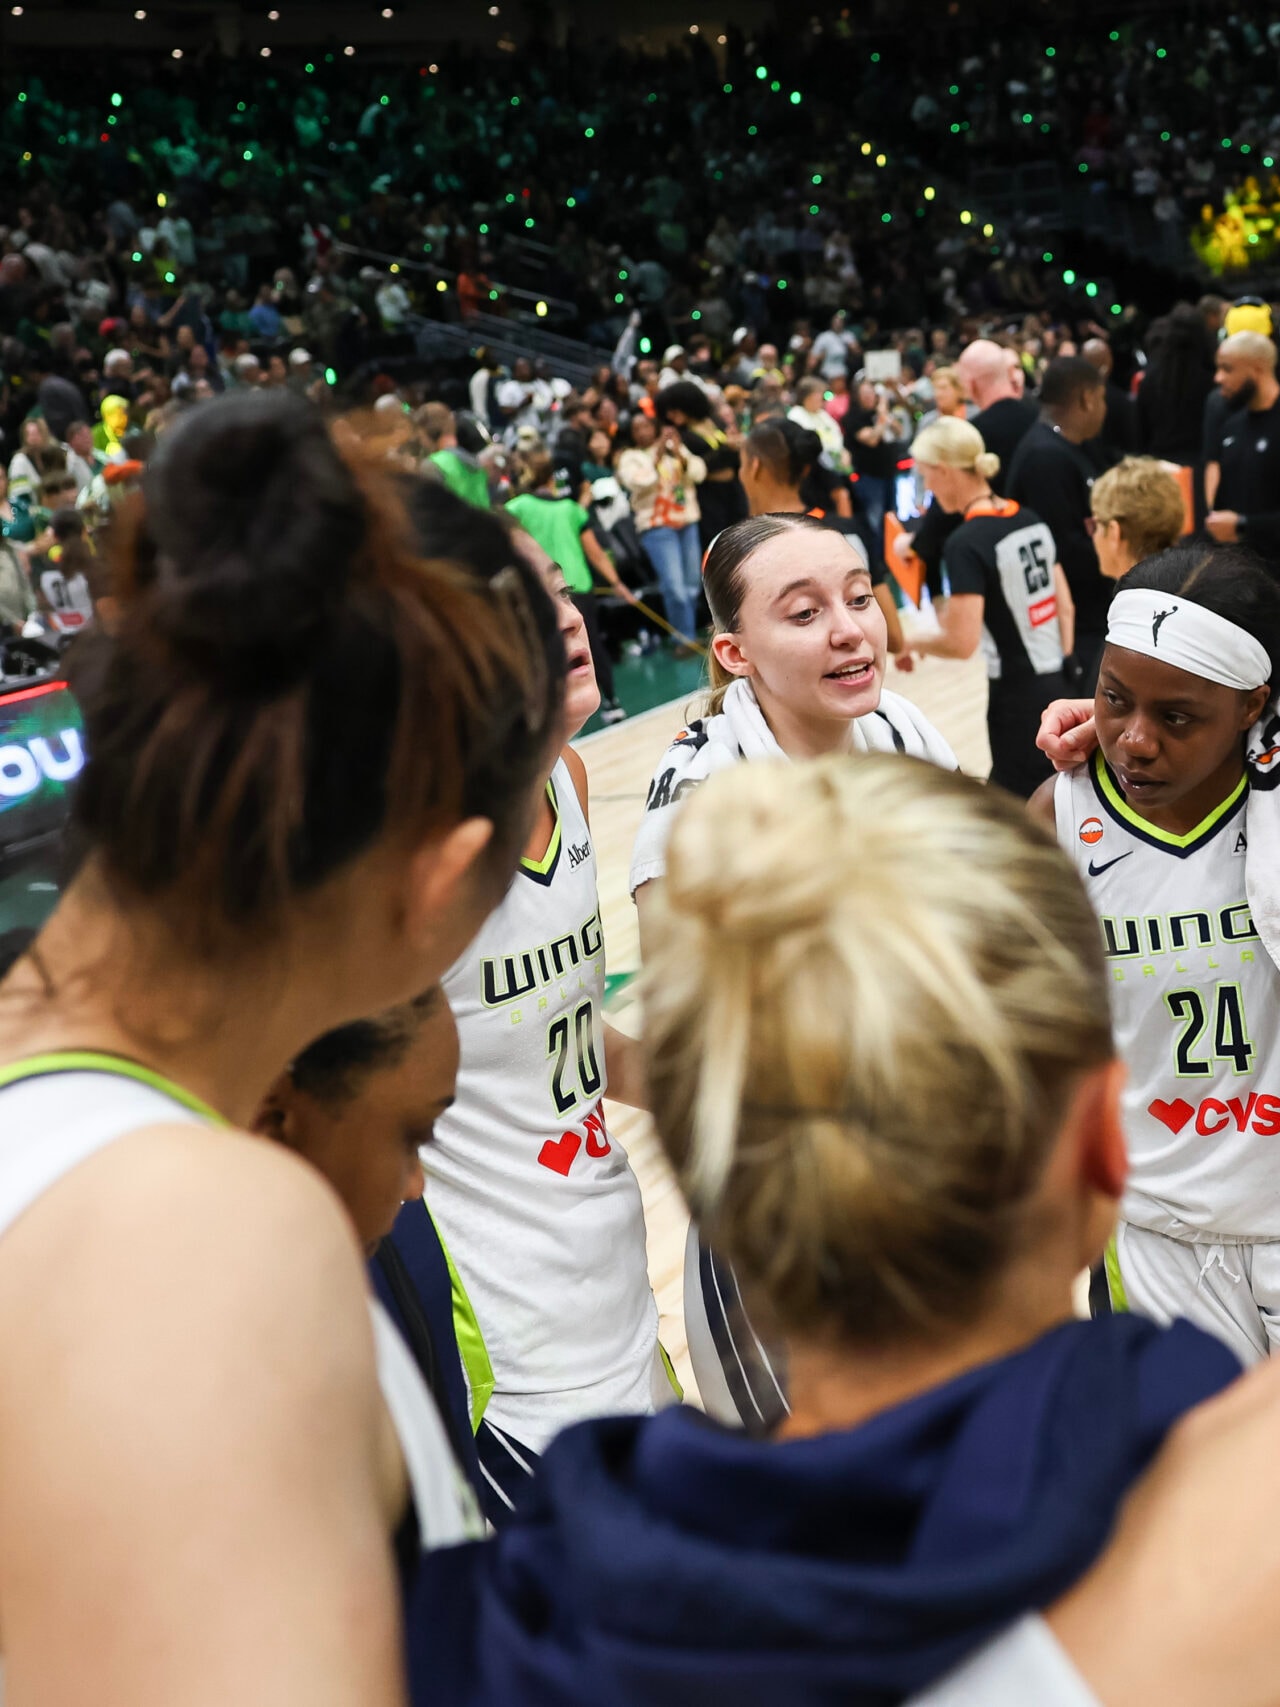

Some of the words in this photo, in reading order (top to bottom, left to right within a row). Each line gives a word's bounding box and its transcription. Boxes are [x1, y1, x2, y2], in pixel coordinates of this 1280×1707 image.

[1018, 539, 1050, 595] 25
[567, 839, 592, 869] Alber
[1101, 899, 1262, 959] WING
[480, 910, 605, 1009] WING
[1113, 950, 1254, 981] DALLA
[545, 997, 602, 1120] 20
[1163, 981, 1257, 1078] 24
